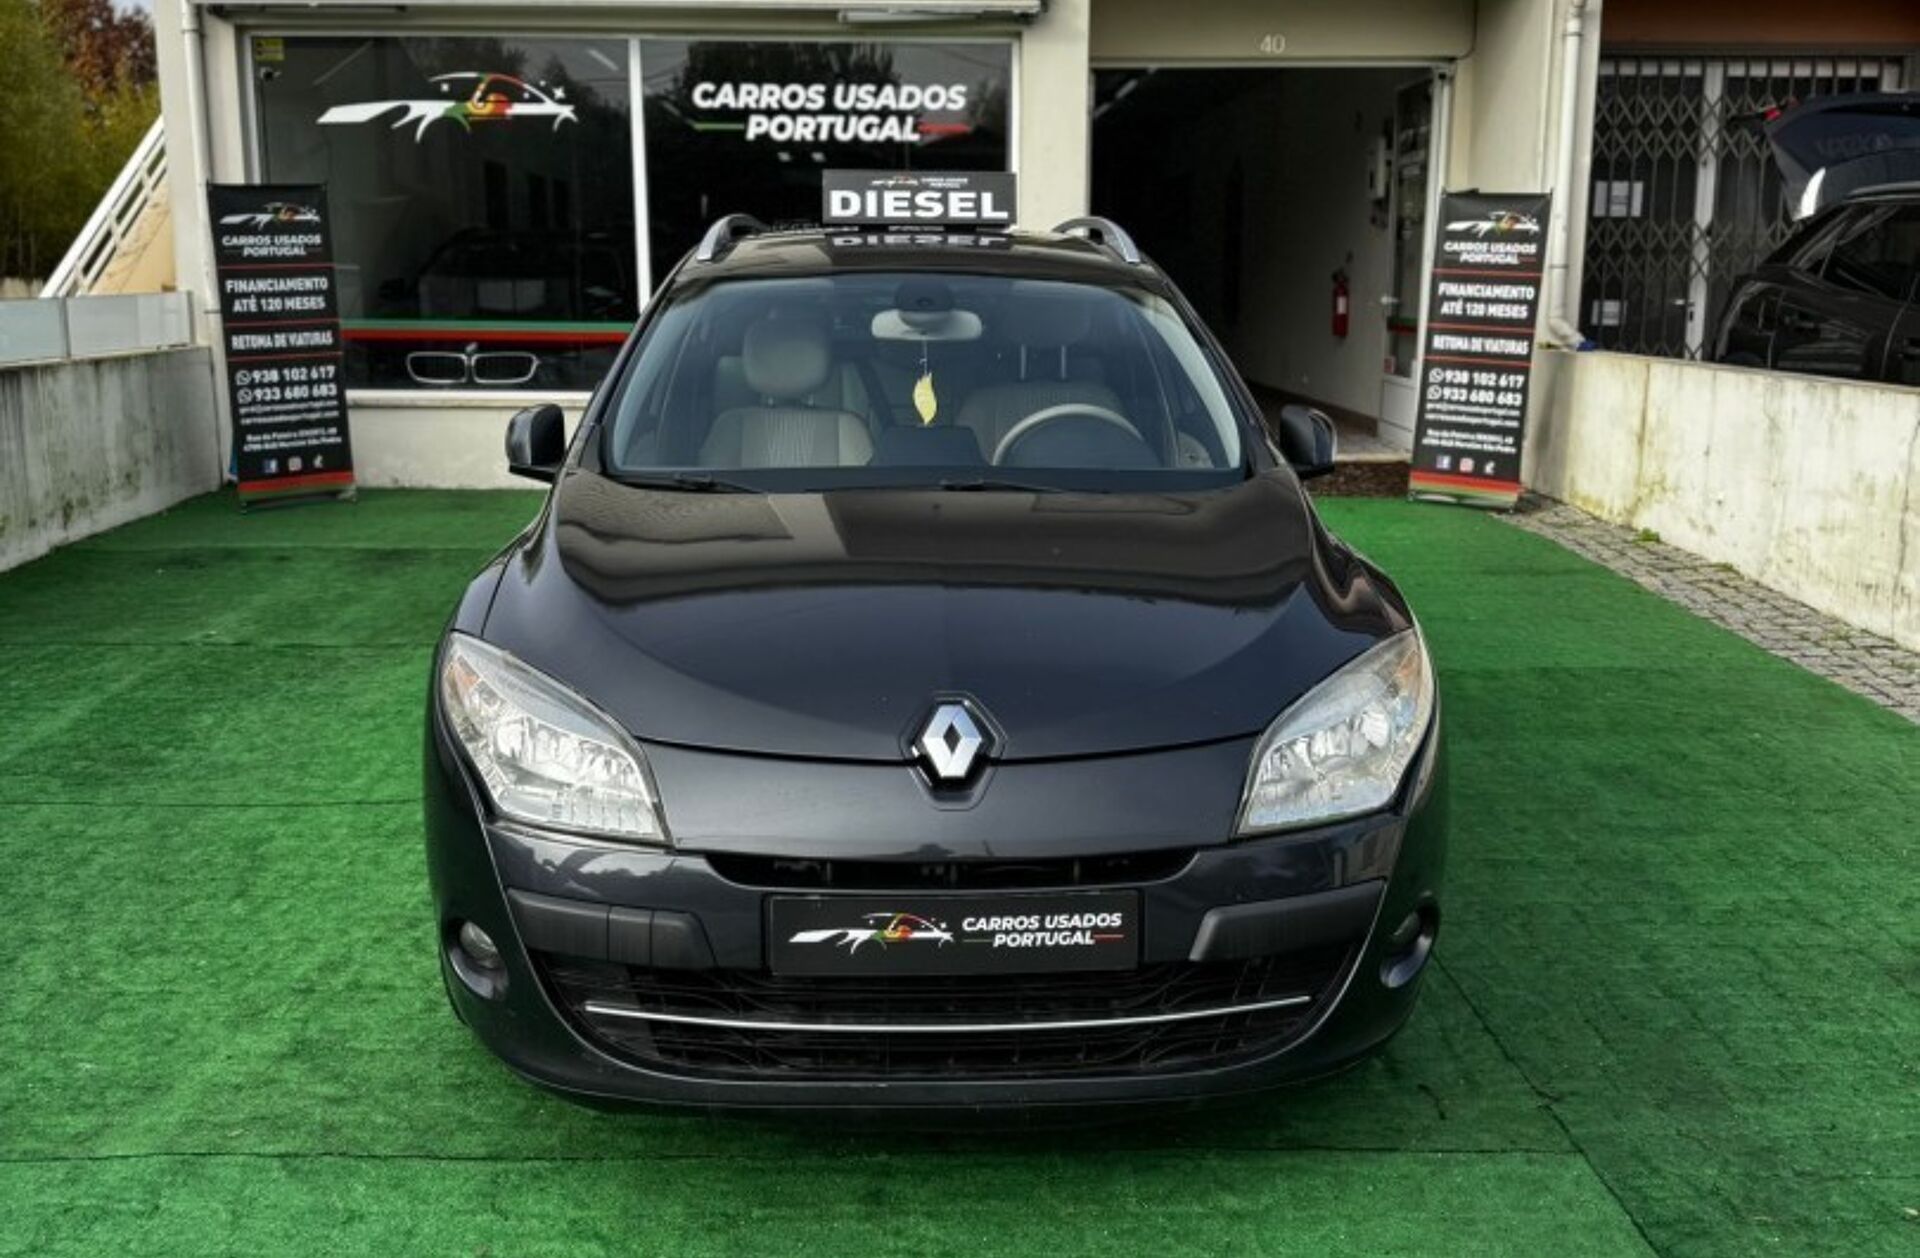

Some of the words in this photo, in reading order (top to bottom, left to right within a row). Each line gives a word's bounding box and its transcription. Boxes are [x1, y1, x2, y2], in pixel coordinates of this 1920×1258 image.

[1260, 34, 1286, 54] 40
[692, 82, 826, 110] CARROS
[833, 83, 967, 111] USADOS
[746, 114, 920, 142] PORTUGAL
[829, 190, 1009, 219] DIESEL
[222, 235, 271, 246] CARROS
[274, 234, 322, 245] USADOS
[1443, 241, 1489, 253] CARROS
[1490, 242, 1537, 254] USADOS
[243, 246, 306, 257] PORTUGAL
[1460, 252, 1520, 264] PORTUGAL
[225, 277, 328, 293] FINANCIAMENTO
[1438, 282, 1535, 300] FINANCIAMENTO
[232, 295, 258, 312] ATÉ
[261, 298, 283, 312] 120
[284, 296, 326, 311] MESES
[1441, 299, 1463, 315] ATÉ
[1466, 302, 1486, 317] 120
[1487, 303, 1528, 319] MESES
[231, 334, 273, 350] RETOMA
[274, 332, 287, 348] DE
[288, 330, 333, 347] VIATURAS
[1432, 334, 1468, 351] RETOMA
[1471, 337, 1482, 352] DE
[1484, 337, 1529, 355] VIATURAS
[252, 369, 279, 384] 938
[282, 367, 308, 381] 102
[310, 365, 336, 379] 617
[1445, 369, 1470, 384] 938
[1473, 371, 1497, 386] 102
[1499, 373, 1525, 388] 617
[253, 387, 281, 402] 933
[284, 384, 309, 399] 680
[312, 382, 337, 397] 683
[1443, 386, 1468, 402] 933
[1469, 389, 1495, 404] 680
[1497, 391, 1522, 406] 683
[961, 915, 1038, 932] CARROS
[1044, 912, 1123, 929] USADOS
[992, 929, 1096, 948] PORTUGAL
